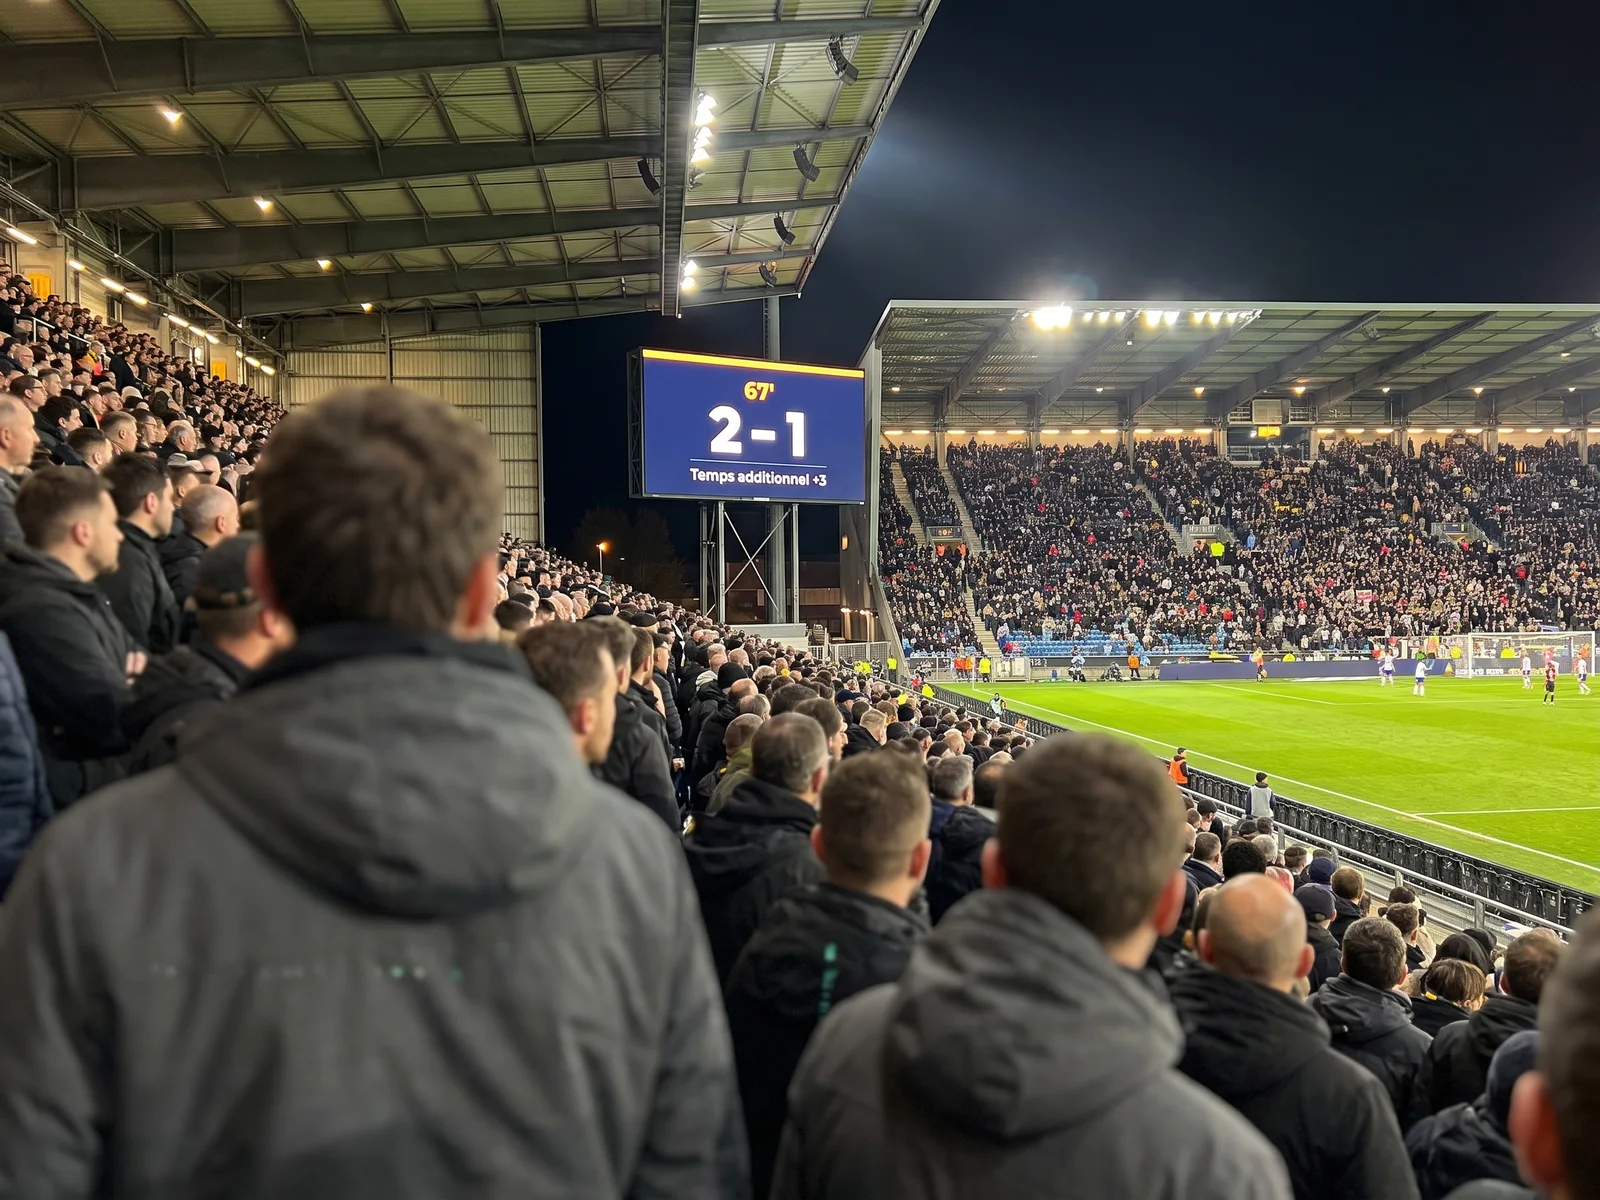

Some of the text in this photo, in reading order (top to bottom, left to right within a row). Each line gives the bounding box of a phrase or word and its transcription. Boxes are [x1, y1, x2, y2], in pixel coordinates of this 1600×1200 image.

[744, 381, 775, 401] 67'
[689, 468, 827, 487] Temps additionnel +3
